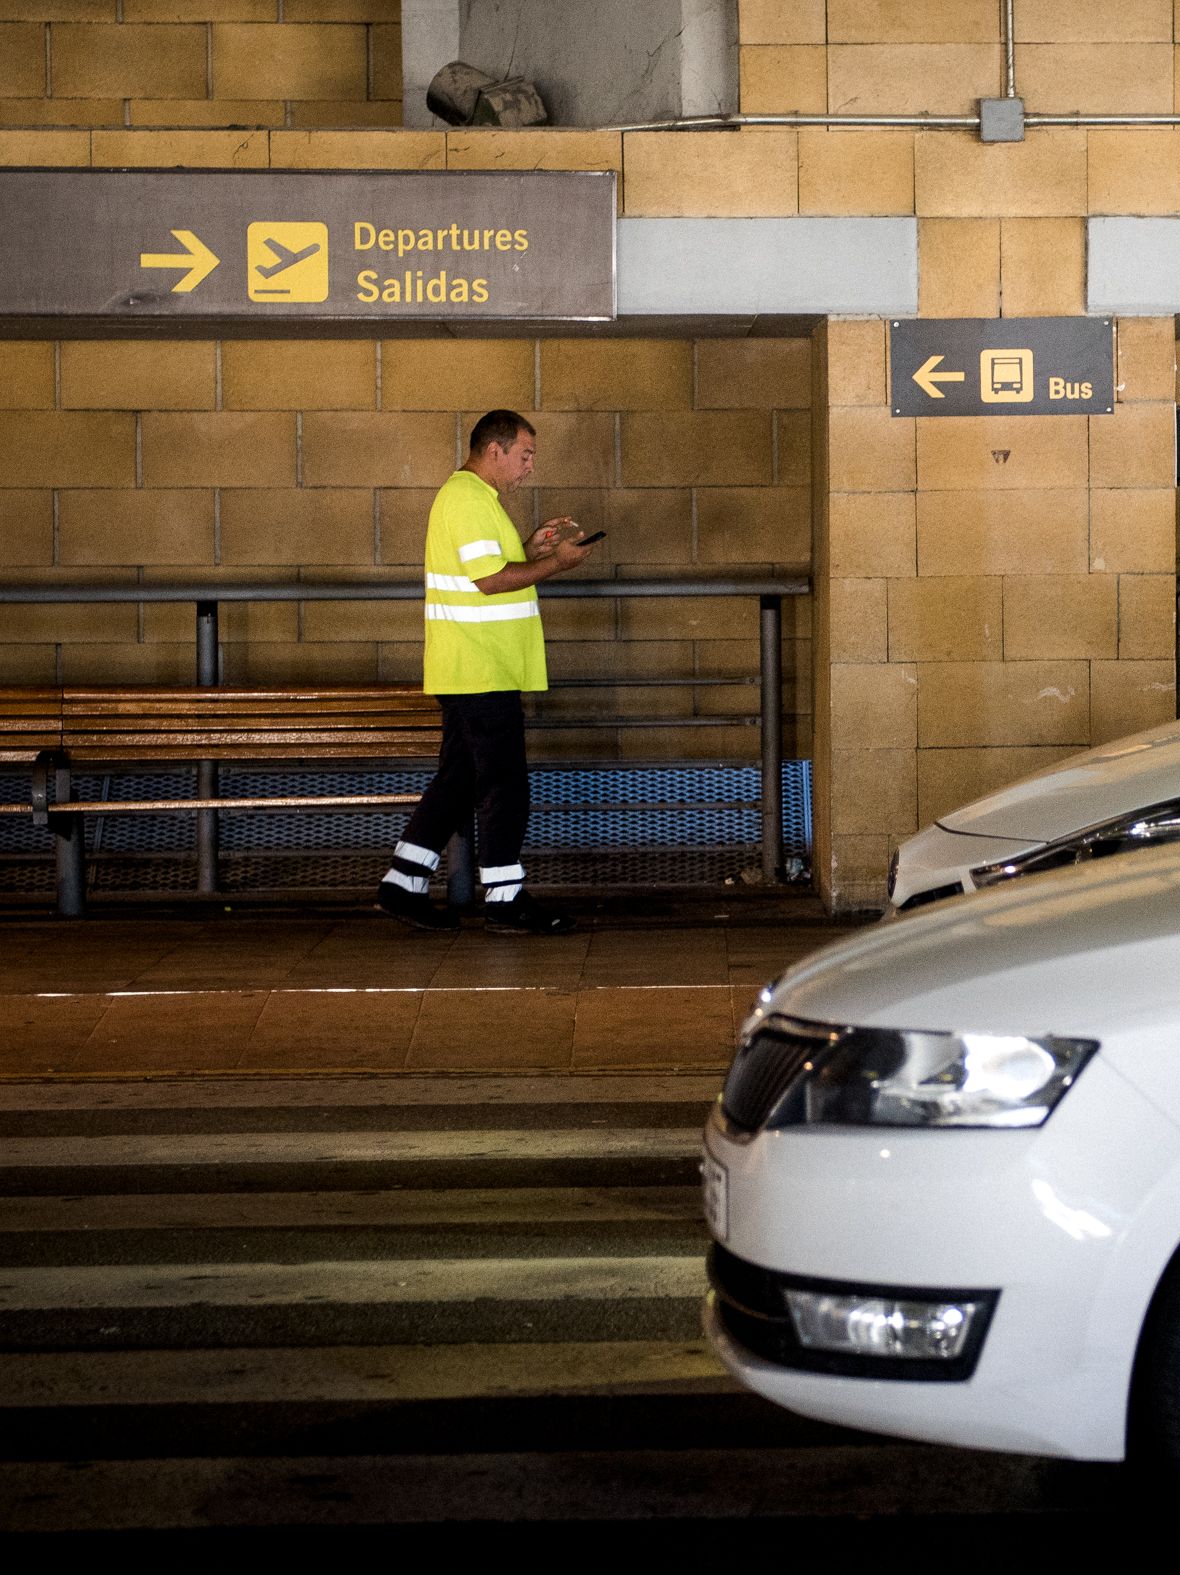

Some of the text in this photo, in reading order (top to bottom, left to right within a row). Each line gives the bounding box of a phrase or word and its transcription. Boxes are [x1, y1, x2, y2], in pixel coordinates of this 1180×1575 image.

[354, 222, 529, 257] Departures
[356, 270, 489, 303] Salidas
[1049, 377, 1093, 400] Bus
